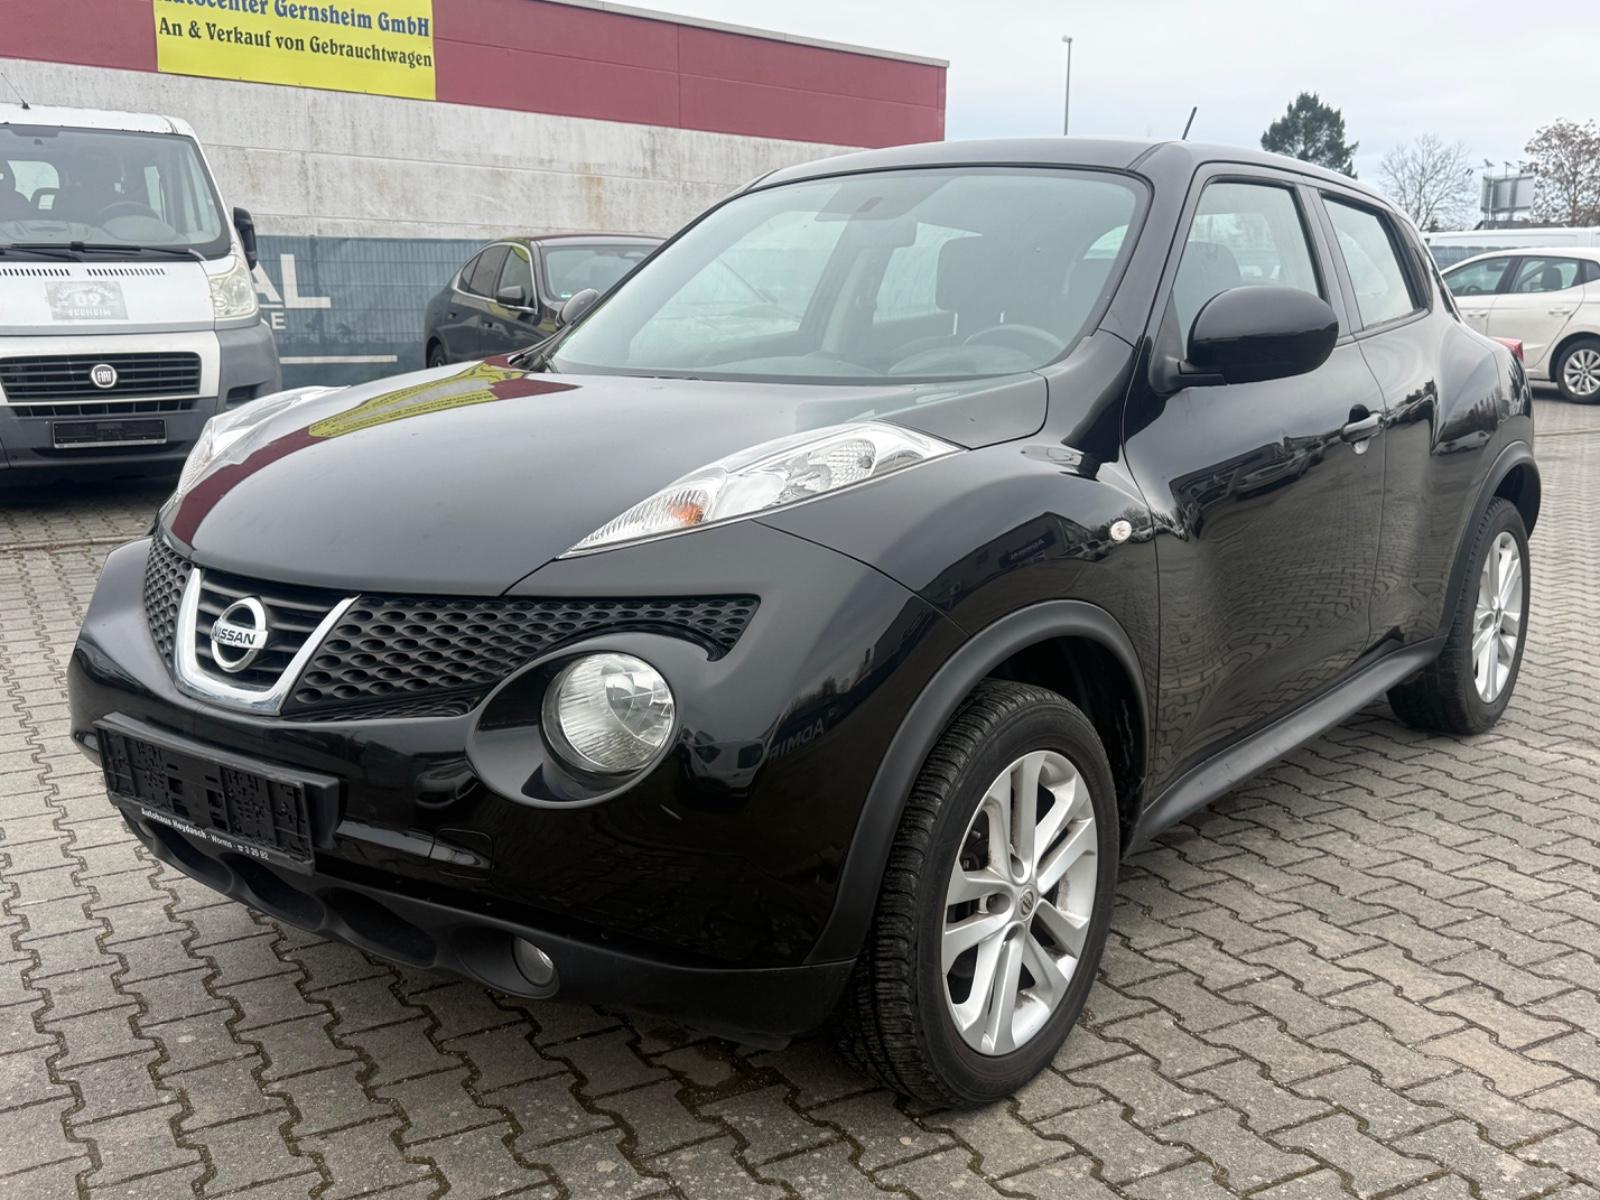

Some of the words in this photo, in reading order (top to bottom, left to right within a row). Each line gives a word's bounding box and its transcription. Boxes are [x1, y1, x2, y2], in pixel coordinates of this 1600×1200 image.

[274, 0, 372, 29] Gernsheim
[377, 11, 430, 37] GmbH
[159, 17, 183, 37] An
[188, 20, 201, 39] &
[205, 22, 271, 48] Verkauf
[275, 37, 305, 52] von
[309, 35, 433, 69] Gebrauchtwagen
[96, 369, 112, 383] FIAT
[213, 625, 256, 646] NISSAN
